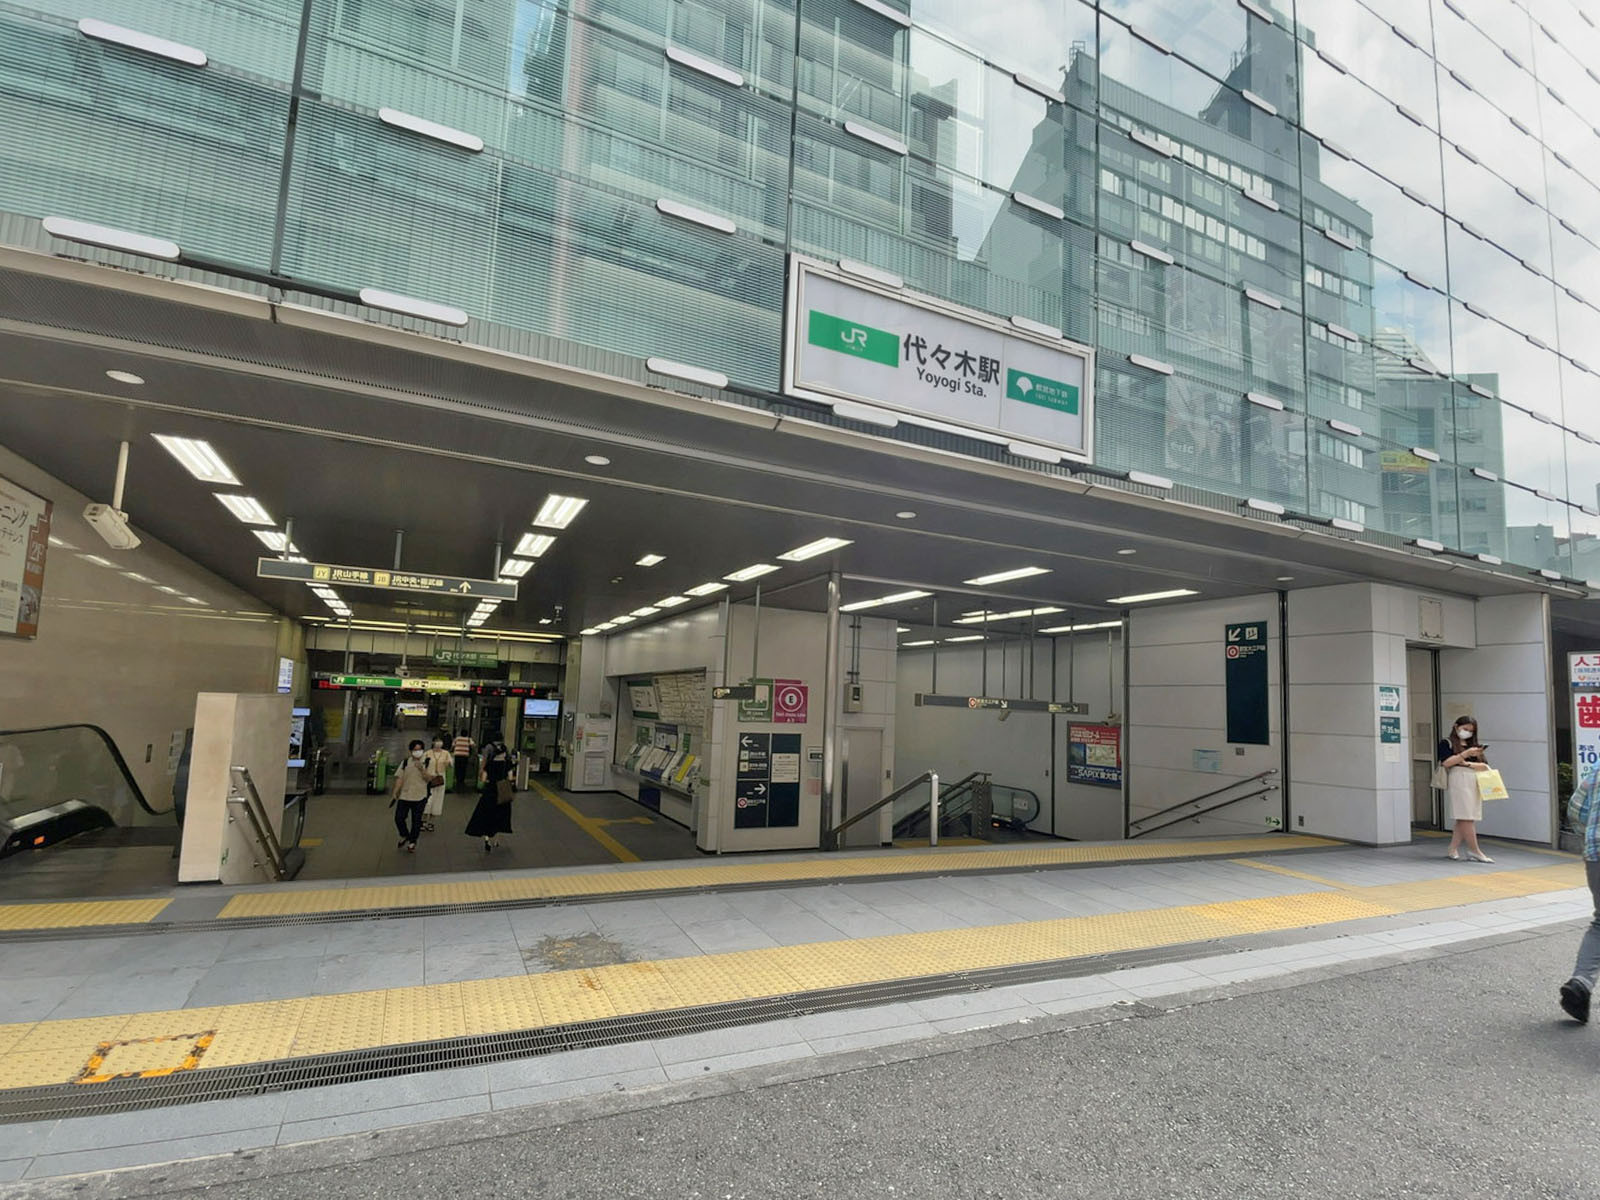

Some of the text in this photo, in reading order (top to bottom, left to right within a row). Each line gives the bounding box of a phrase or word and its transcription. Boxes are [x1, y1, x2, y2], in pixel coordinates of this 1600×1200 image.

[841, 328, 868, 347] JR
[903, 333, 1000, 386] 代々木駅
[916, 366, 987, 398] Yoyogi Sta.
[0, 505, 29, 529] ニング
[435, 651, 452, 660] JR
